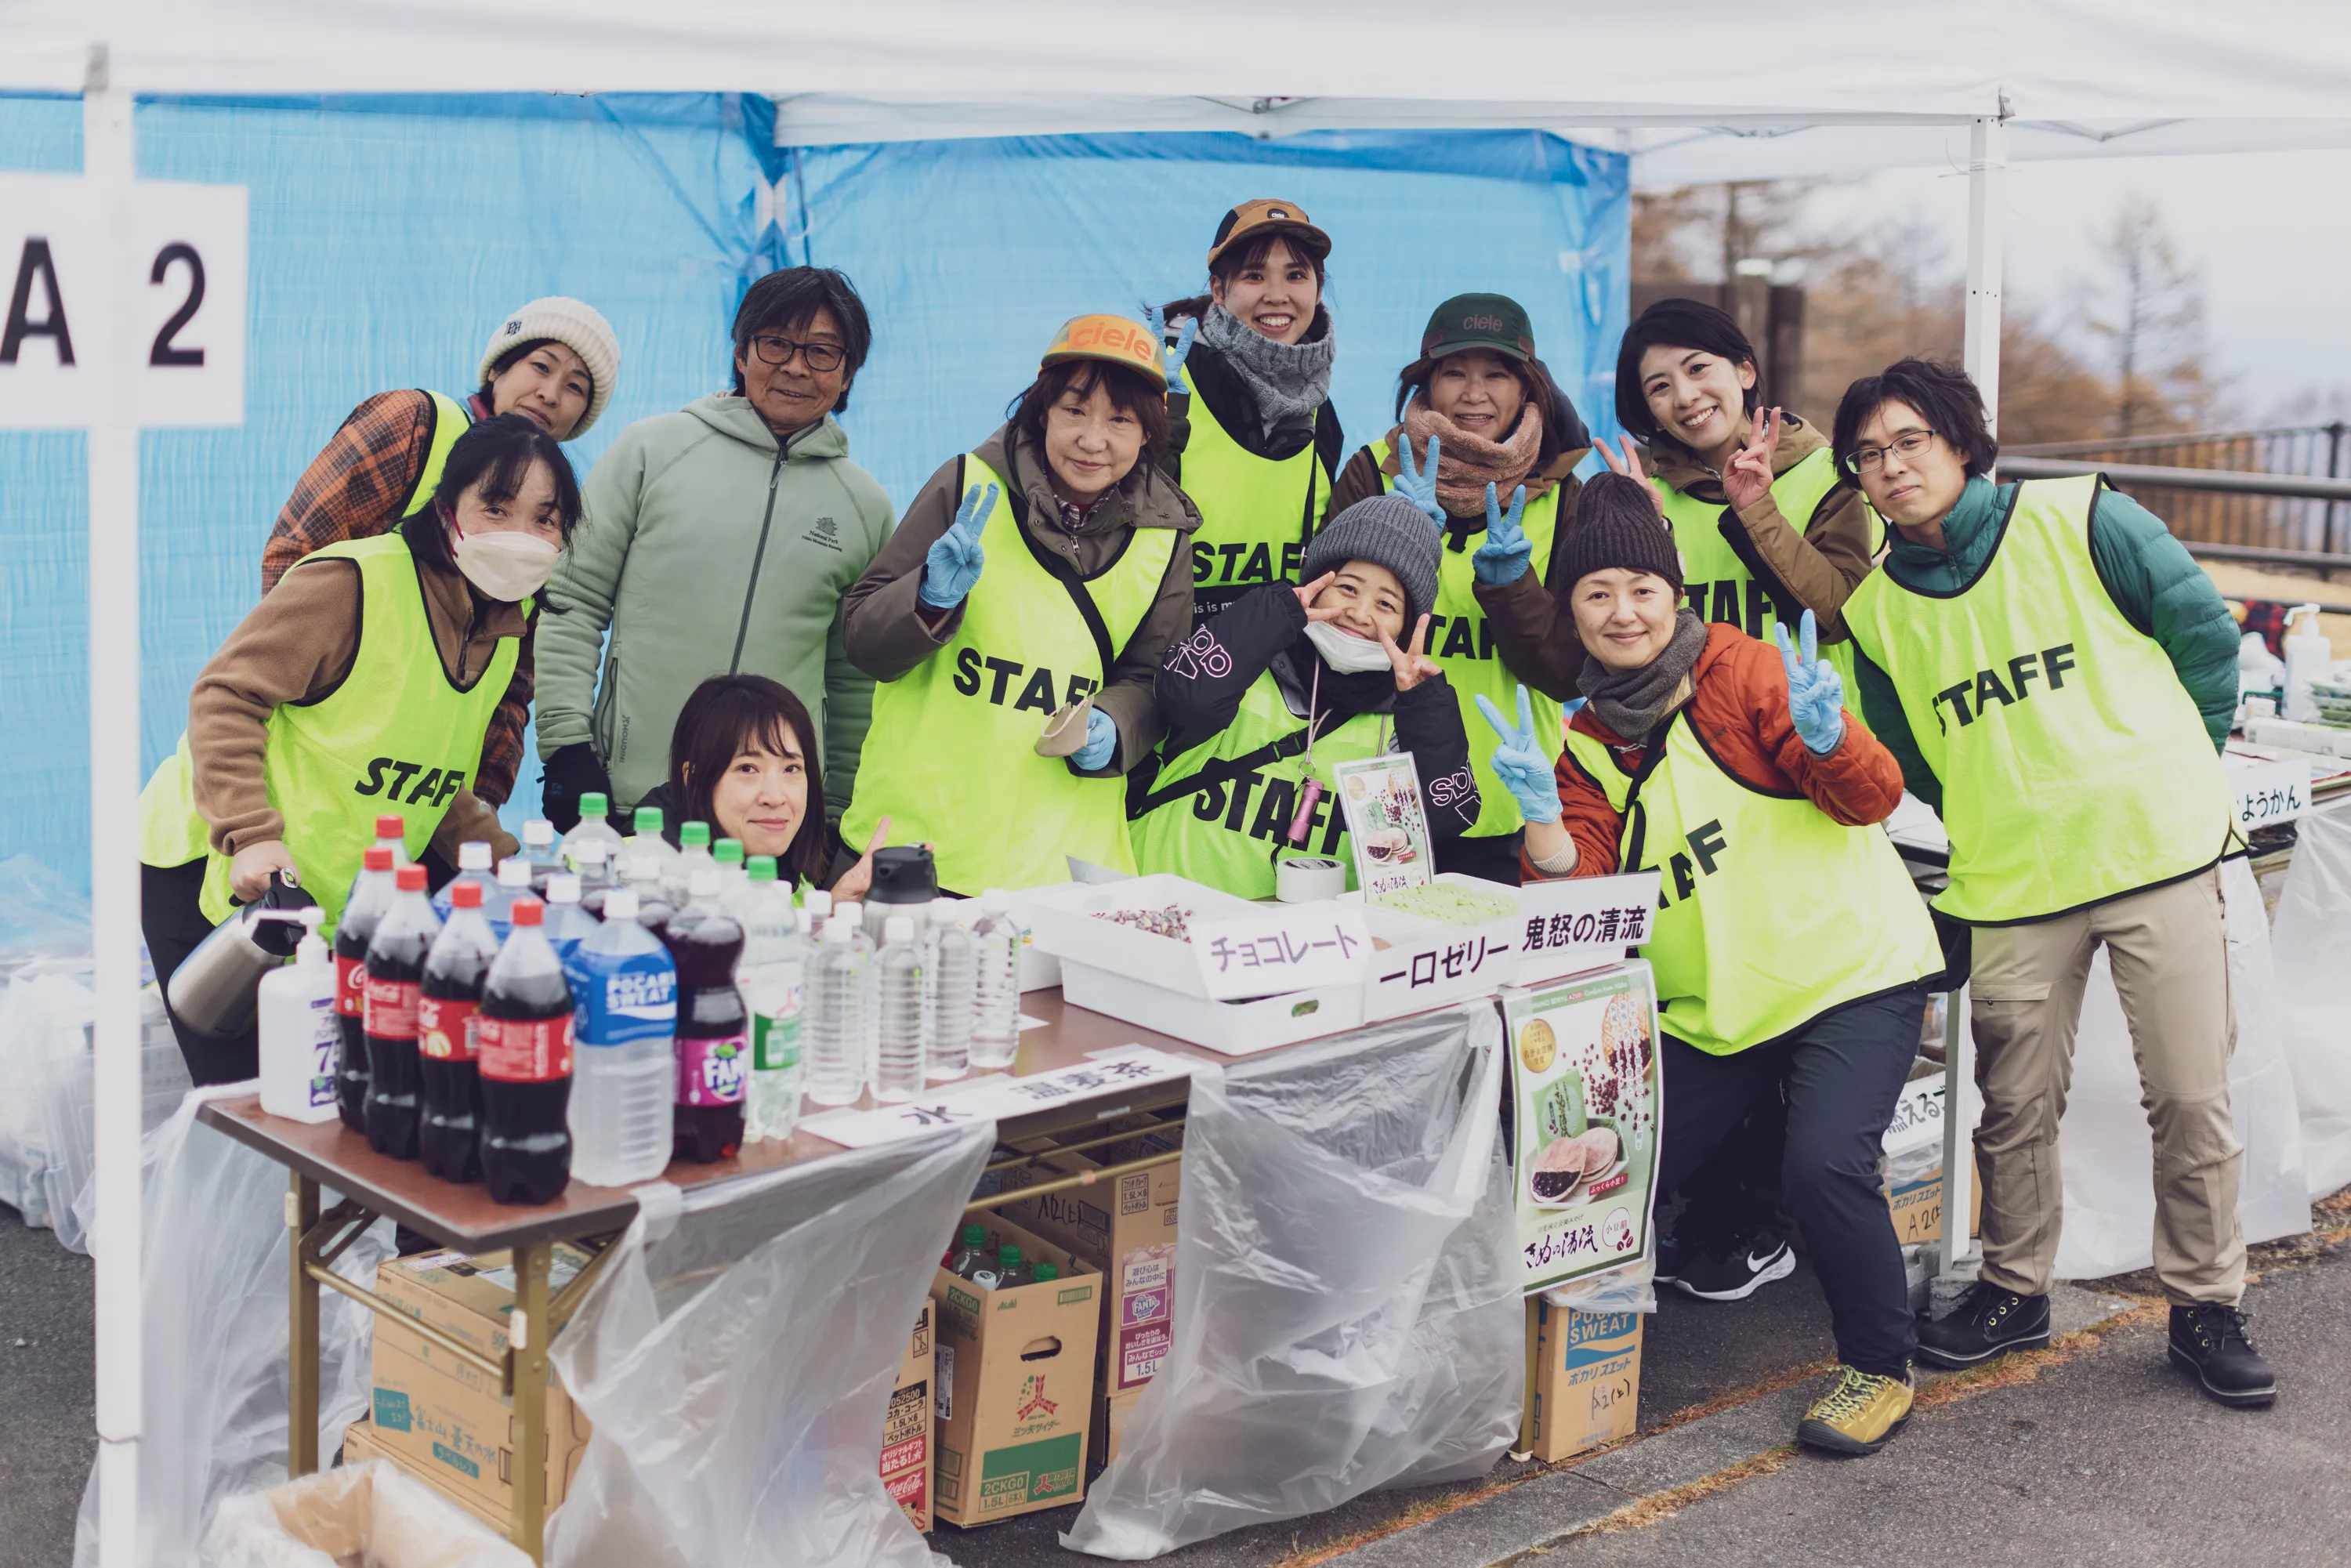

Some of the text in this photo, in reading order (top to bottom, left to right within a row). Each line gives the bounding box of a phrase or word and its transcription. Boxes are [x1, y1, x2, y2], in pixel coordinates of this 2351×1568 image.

[0, 237, 205, 367] A 2
[1463, 313, 1503, 332] ciele
[1072, 322, 1151, 360] ciele
[809, 531, 828, 541] National
[1192, 541, 1302, 582] STAF
[1207, 602, 1218, 612] is
[953, 647, 1099, 716] STAF
[619, 724, 630, 763] HOUDINI
[354, 757, 465, 807] STAF
[2237, 785, 2301, 821] ようかん
[1522, 905, 1646, 952] 鬼怒の清流
[1211, 925, 1358, 972] チョコレート
[1380, 936, 1509, 989] 一口ゼリー
[1568, 991, 1583, 1001] AZUKI
[704, 1056, 744, 1088] FAN
[900, 1106, 973, 1124] 水
[1125, 1272, 1165, 1287] みんなの中に
[1132, 1264, 1159, 1276] 遊び心は
[998, 1298, 1017, 1311] Asahi
[1133, 1297, 1156, 1313] FANTA
[1570, 1313, 1630, 1344] SWEAT
[1125, 1334, 1168, 1349] おいしさを選ぼう。
[1128, 1348, 1167, 1363] みんなでシェア
[1137, 1360, 1158, 1376] 1.5L
[1568, 1357, 1631, 1386] ポカリ スエット
[891, 1388, 920, 1407] 052500
[887, 1399, 924, 1419] コカ・コーラ
[888, 1424, 922, 1442] ペットボトル
[1012, 1420, 1060, 1438] 三ツ矢サイダー
[882, 1440, 923, 1461] オリジナルギフト
[984, 1497, 1004, 1508] 1.5L
